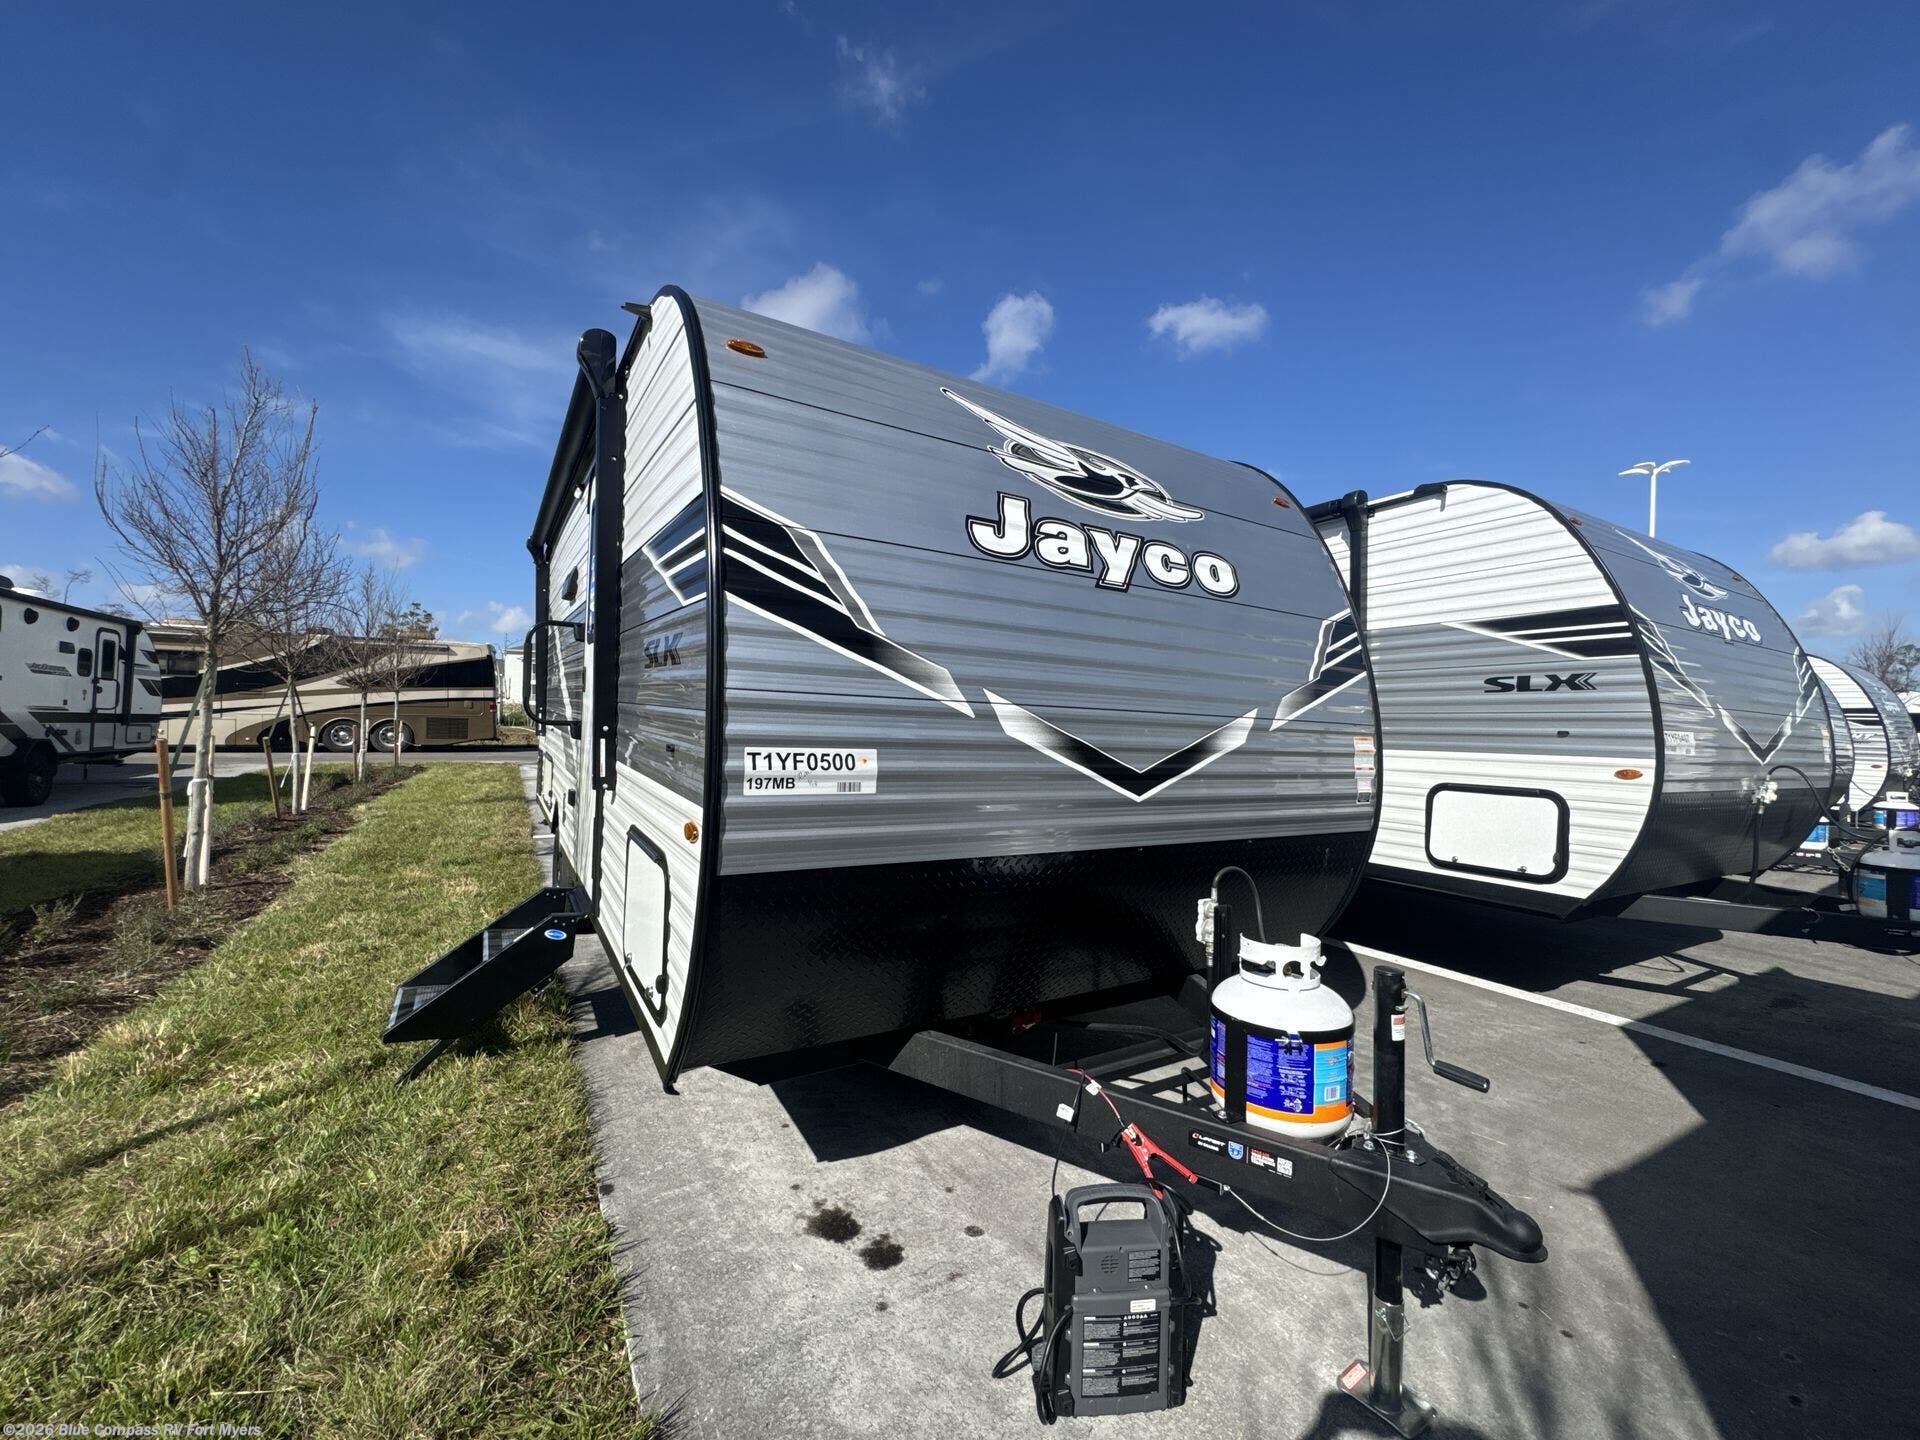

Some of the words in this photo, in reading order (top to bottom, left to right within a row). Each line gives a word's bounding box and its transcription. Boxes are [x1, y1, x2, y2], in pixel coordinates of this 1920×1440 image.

[965, 491, 1240, 598] Jayco
[1681, 593, 1762, 645] Jayco
[1484, 672, 1598, 693] SLX
[746, 752, 856, 771] T1YF0500
[746, 777, 796, 790] 197MB
